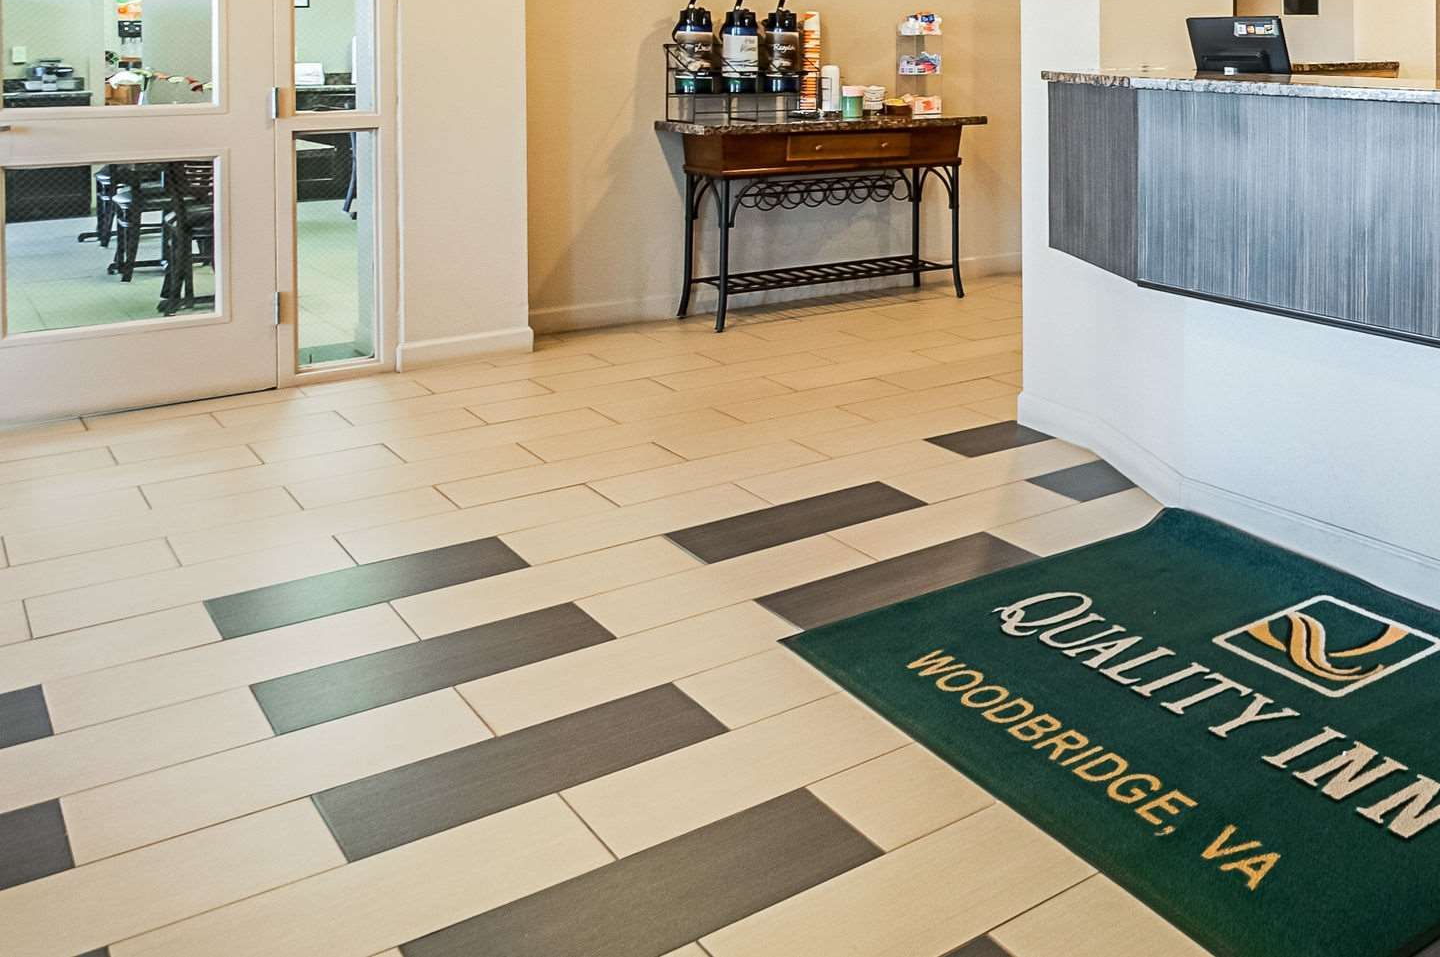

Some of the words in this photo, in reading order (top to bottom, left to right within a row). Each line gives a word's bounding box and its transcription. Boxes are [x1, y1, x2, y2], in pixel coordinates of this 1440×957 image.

[991, 590, 1300, 739] QUALITY
[906, 648, 1199, 837] WOODBRIDGE,
[1200, 825, 1282, 892] VA
